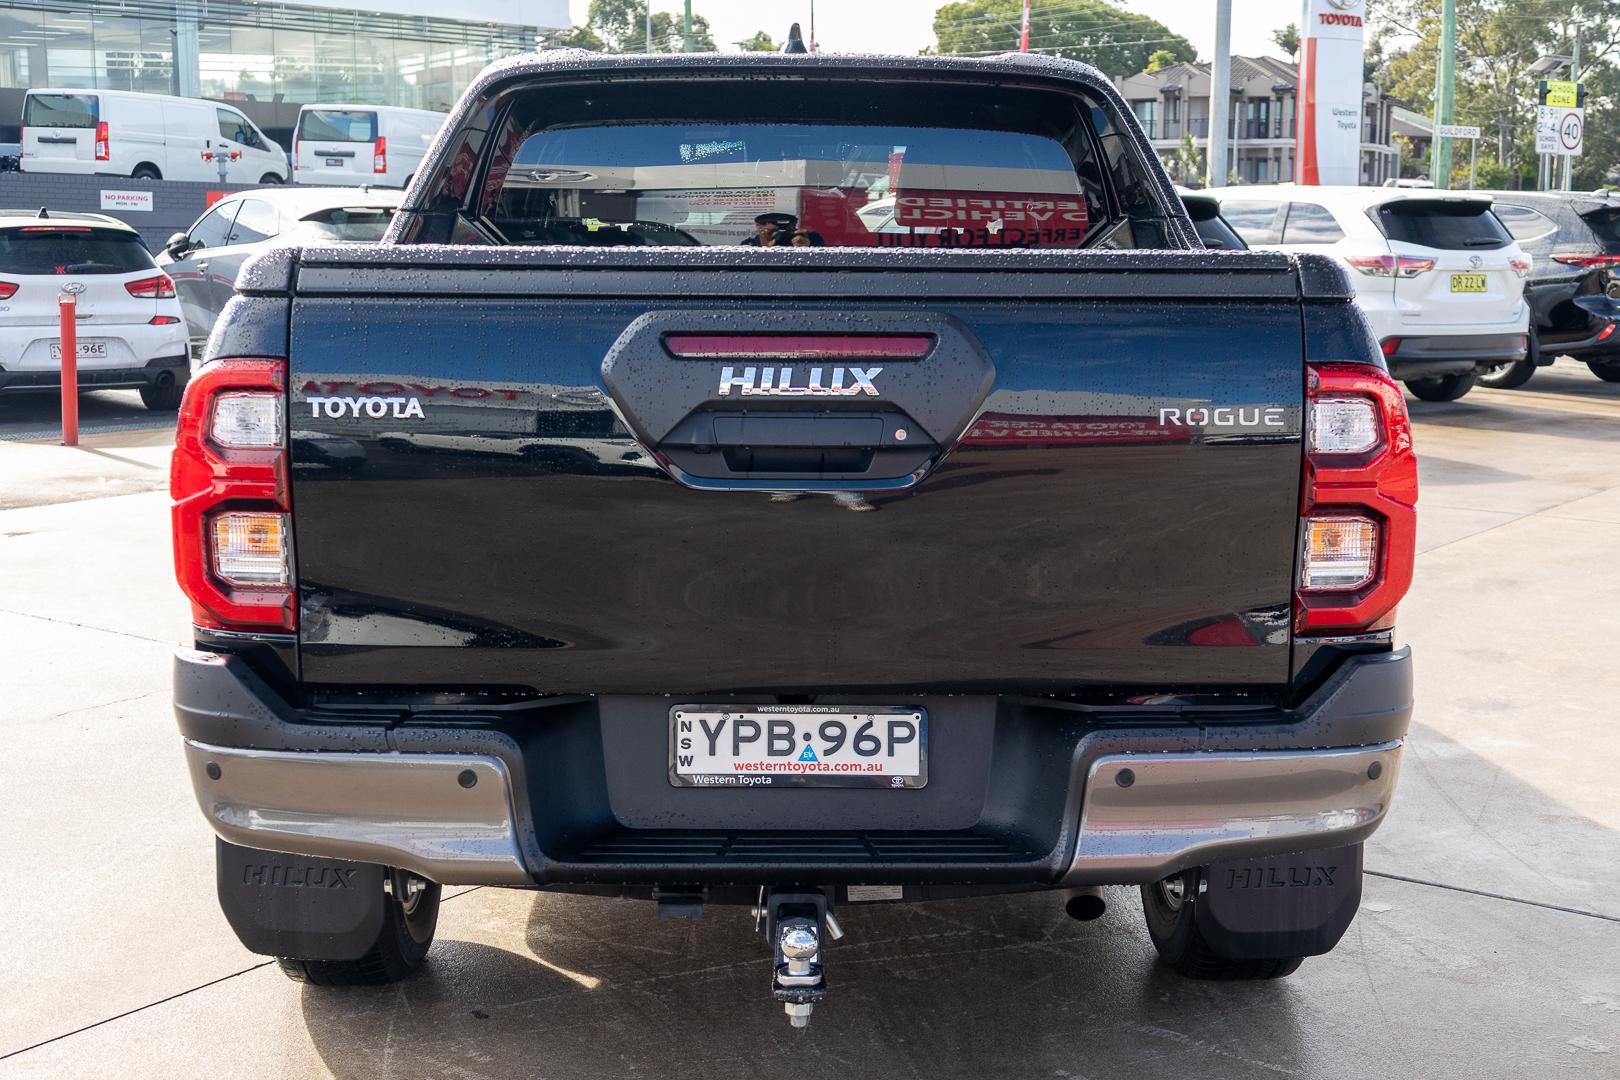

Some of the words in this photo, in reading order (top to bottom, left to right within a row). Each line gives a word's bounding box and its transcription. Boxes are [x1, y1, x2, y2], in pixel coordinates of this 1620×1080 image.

[1318, 13, 1363, 27] TOYOTA
[1549, 84, 1575, 94] SCHOOL
[1552, 95, 1571, 104] ZONE
[1337, 120, 1357, 130] Toyota
[1564, 123, 1579, 140] 40
[718, 366, 884, 396] HILUX
[306, 397, 426, 419] TOYOTA
[1158, 407, 1286, 426] ROGUE
[757, 705, 840, 714] westerntoyota.com.au
[733, 761, 883, 775] westerntoyota.com.au
[692, 775, 736, 784] Western
[737, 775, 772, 786] Toyota
[243, 864, 357, 889] HILUX
[1226, 866, 1337, 889] HILUX
